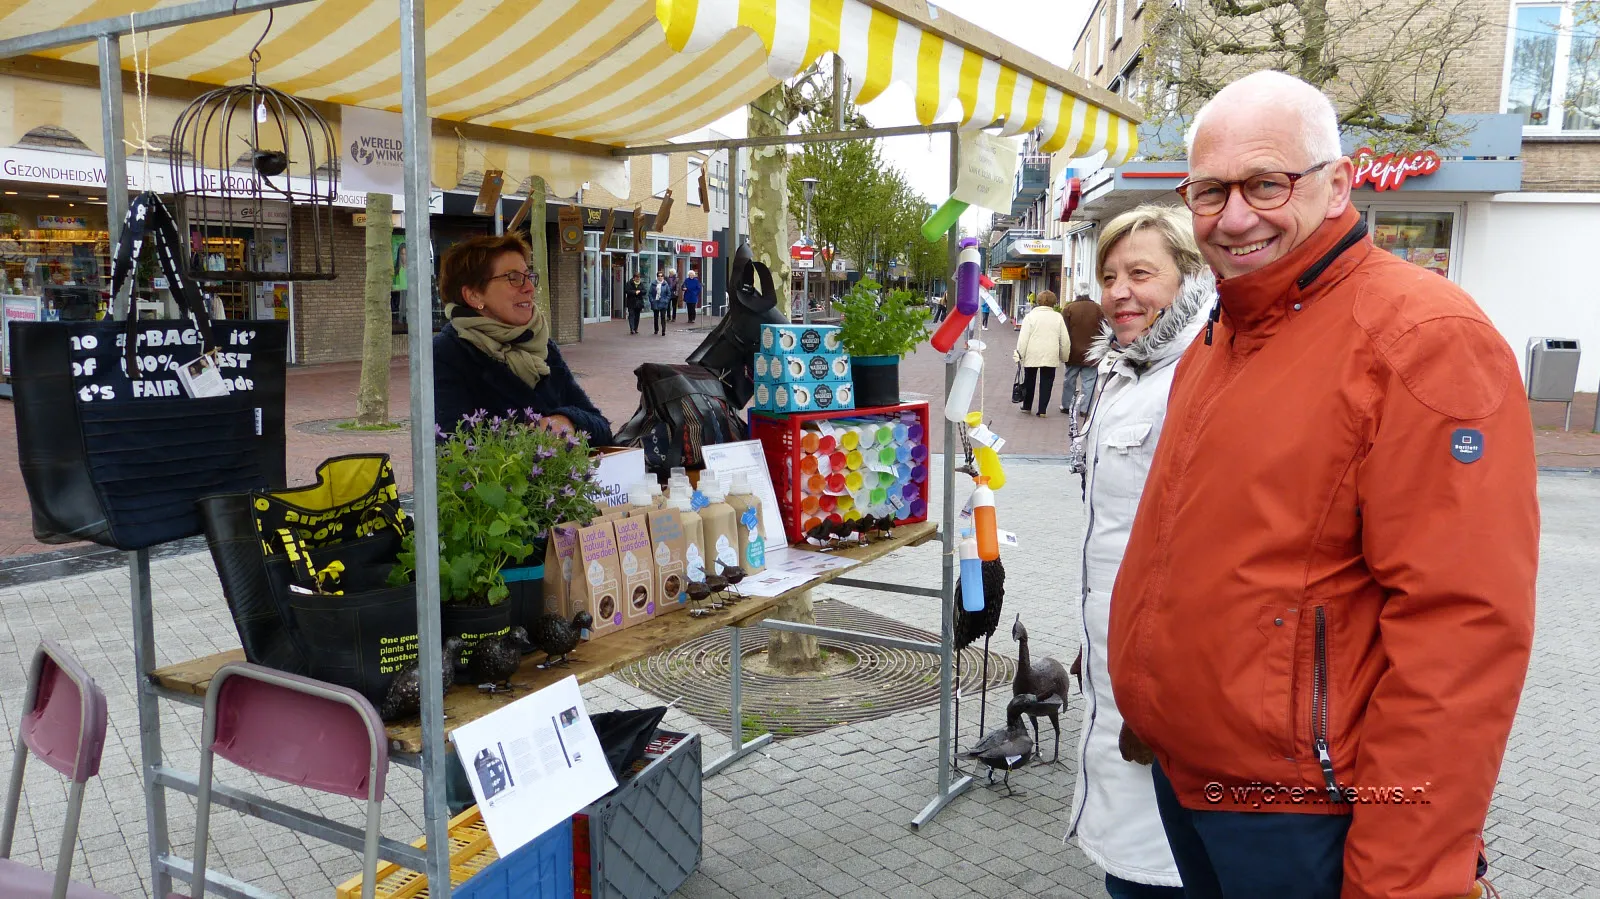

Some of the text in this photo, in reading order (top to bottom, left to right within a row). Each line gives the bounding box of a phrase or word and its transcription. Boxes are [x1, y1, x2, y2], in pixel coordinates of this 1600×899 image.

[360, 136, 403, 151] WERELD
[375, 149, 404, 162] WINK
[4, 159, 138, 187] GEZONDHEIDSWEL
[331, 190, 367, 205] DROGISTE
[115, 329, 204, 348] arBAG
[132, 379, 180, 398] FAIR
[380, 634, 419, 645] One gene
[380, 645, 405, 656] plants
[380, 653, 418, 664] Another
[380, 665, 393, 674] the
